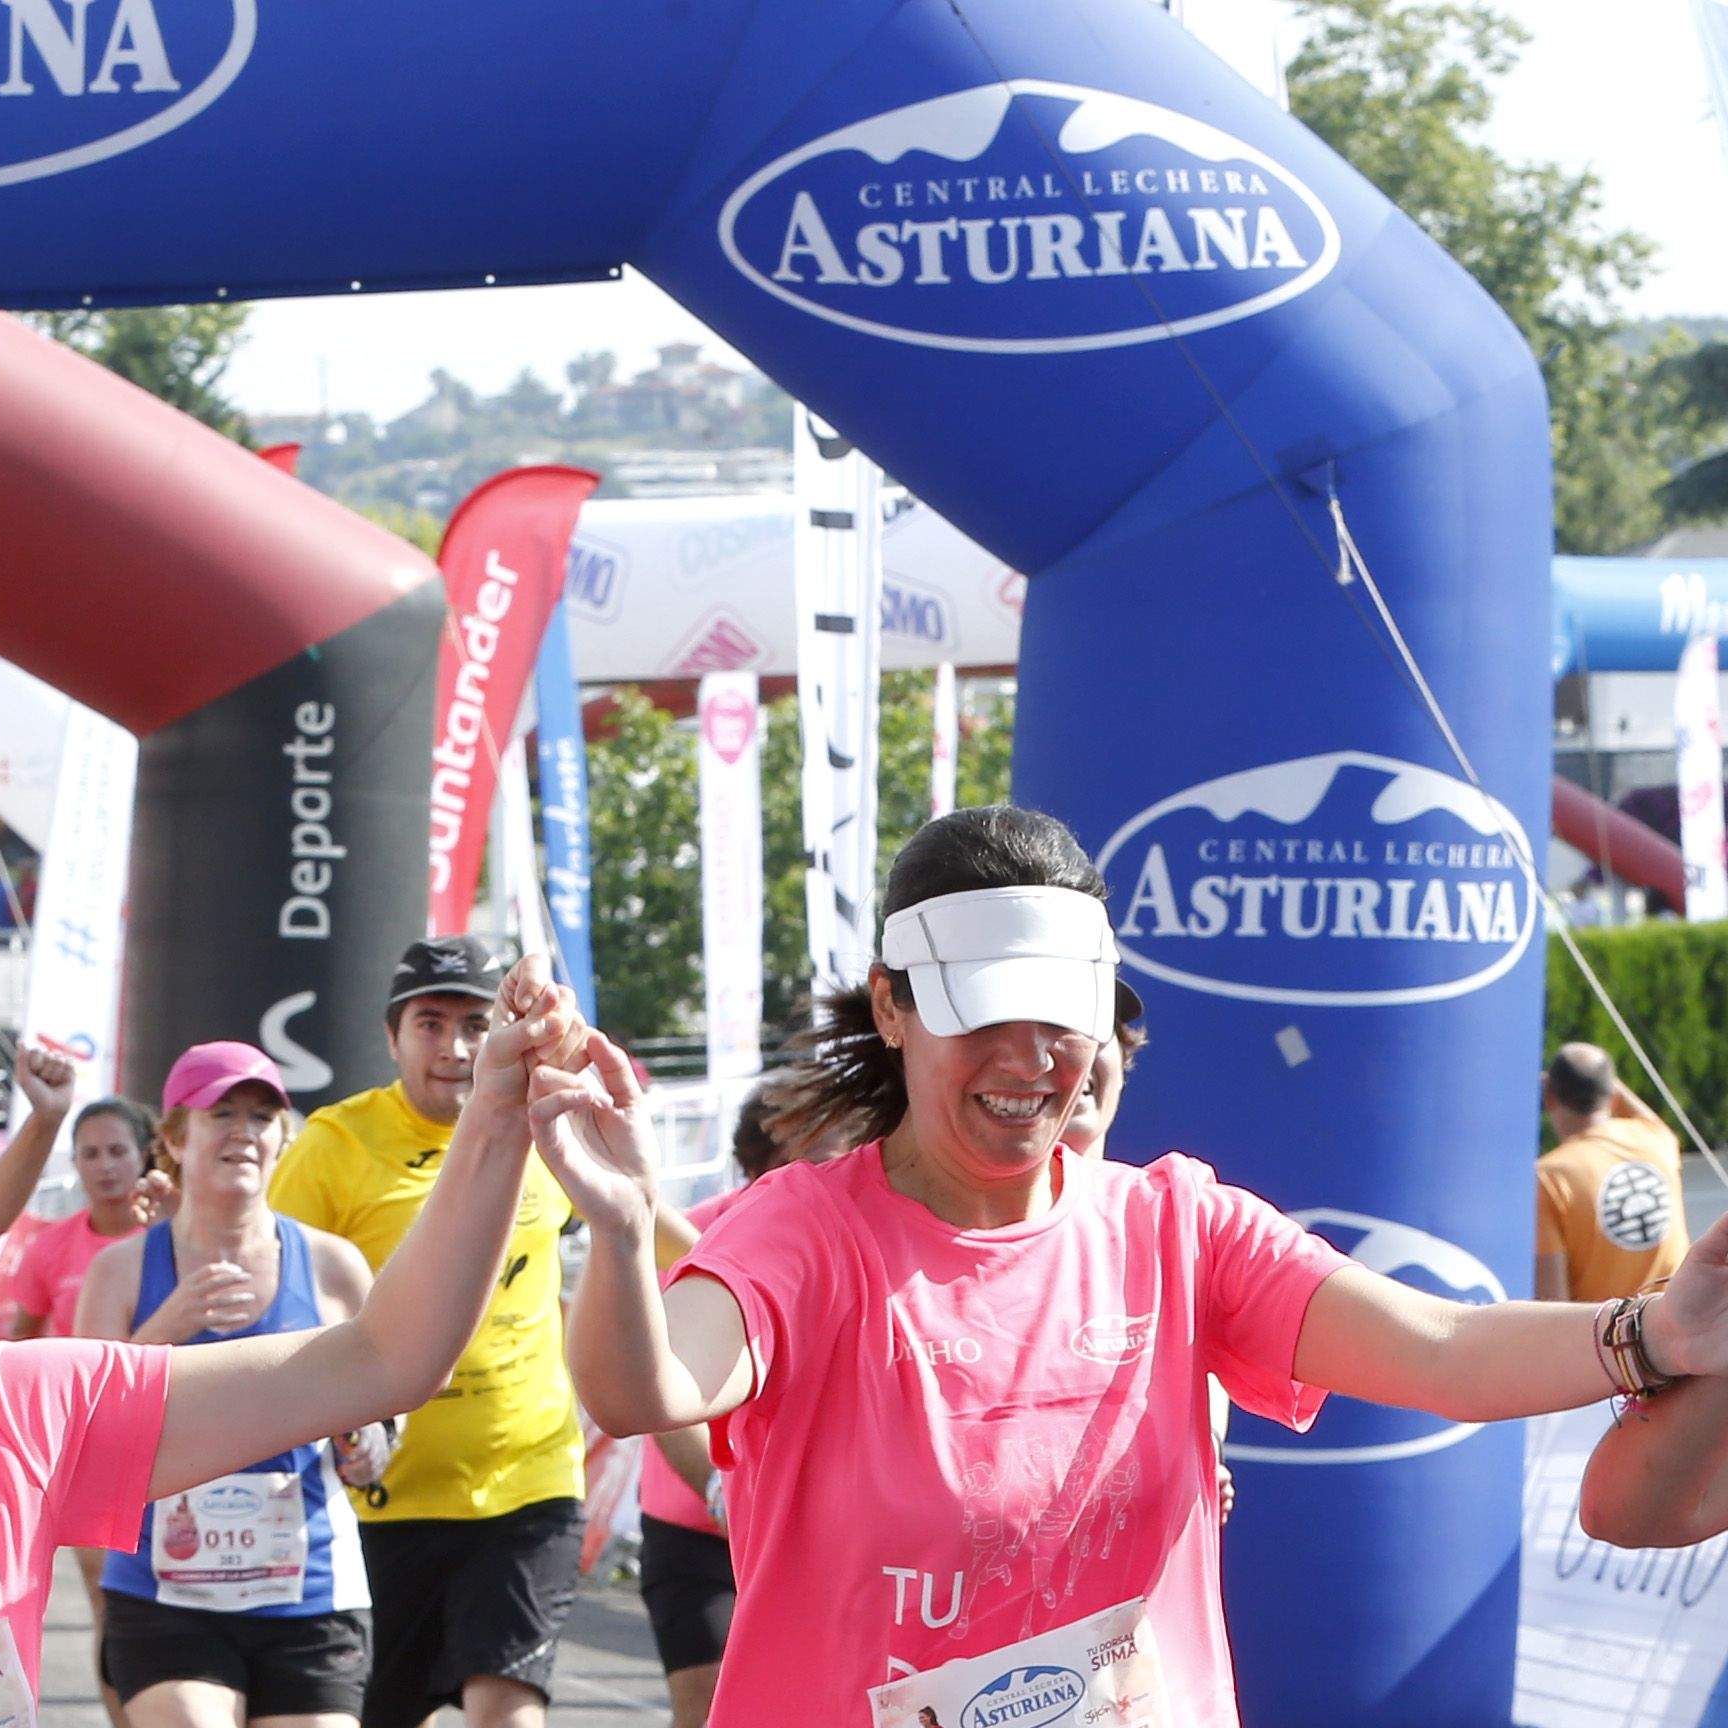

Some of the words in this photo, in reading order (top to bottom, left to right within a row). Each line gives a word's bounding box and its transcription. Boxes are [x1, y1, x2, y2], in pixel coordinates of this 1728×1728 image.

[858, 173, 1062, 209] CENTRAL
[1082, 167, 1270, 198] LECHERA
[771, 190, 1307, 287] ASTURIANA
[278, 700, 348, 940] Deporte
[1198, 837, 1370, 865] CENTRAL
[1118, 844, 1522, 943] ASTURIANA
[204, 1529, 256, 1550] 016
[882, 1565, 964, 1629] TU
[1086, 1647, 1099, 1658] TU
[1099, 1632, 1136, 1653] DORSAL
[1090, 1642, 1139, 1672] SUMA
